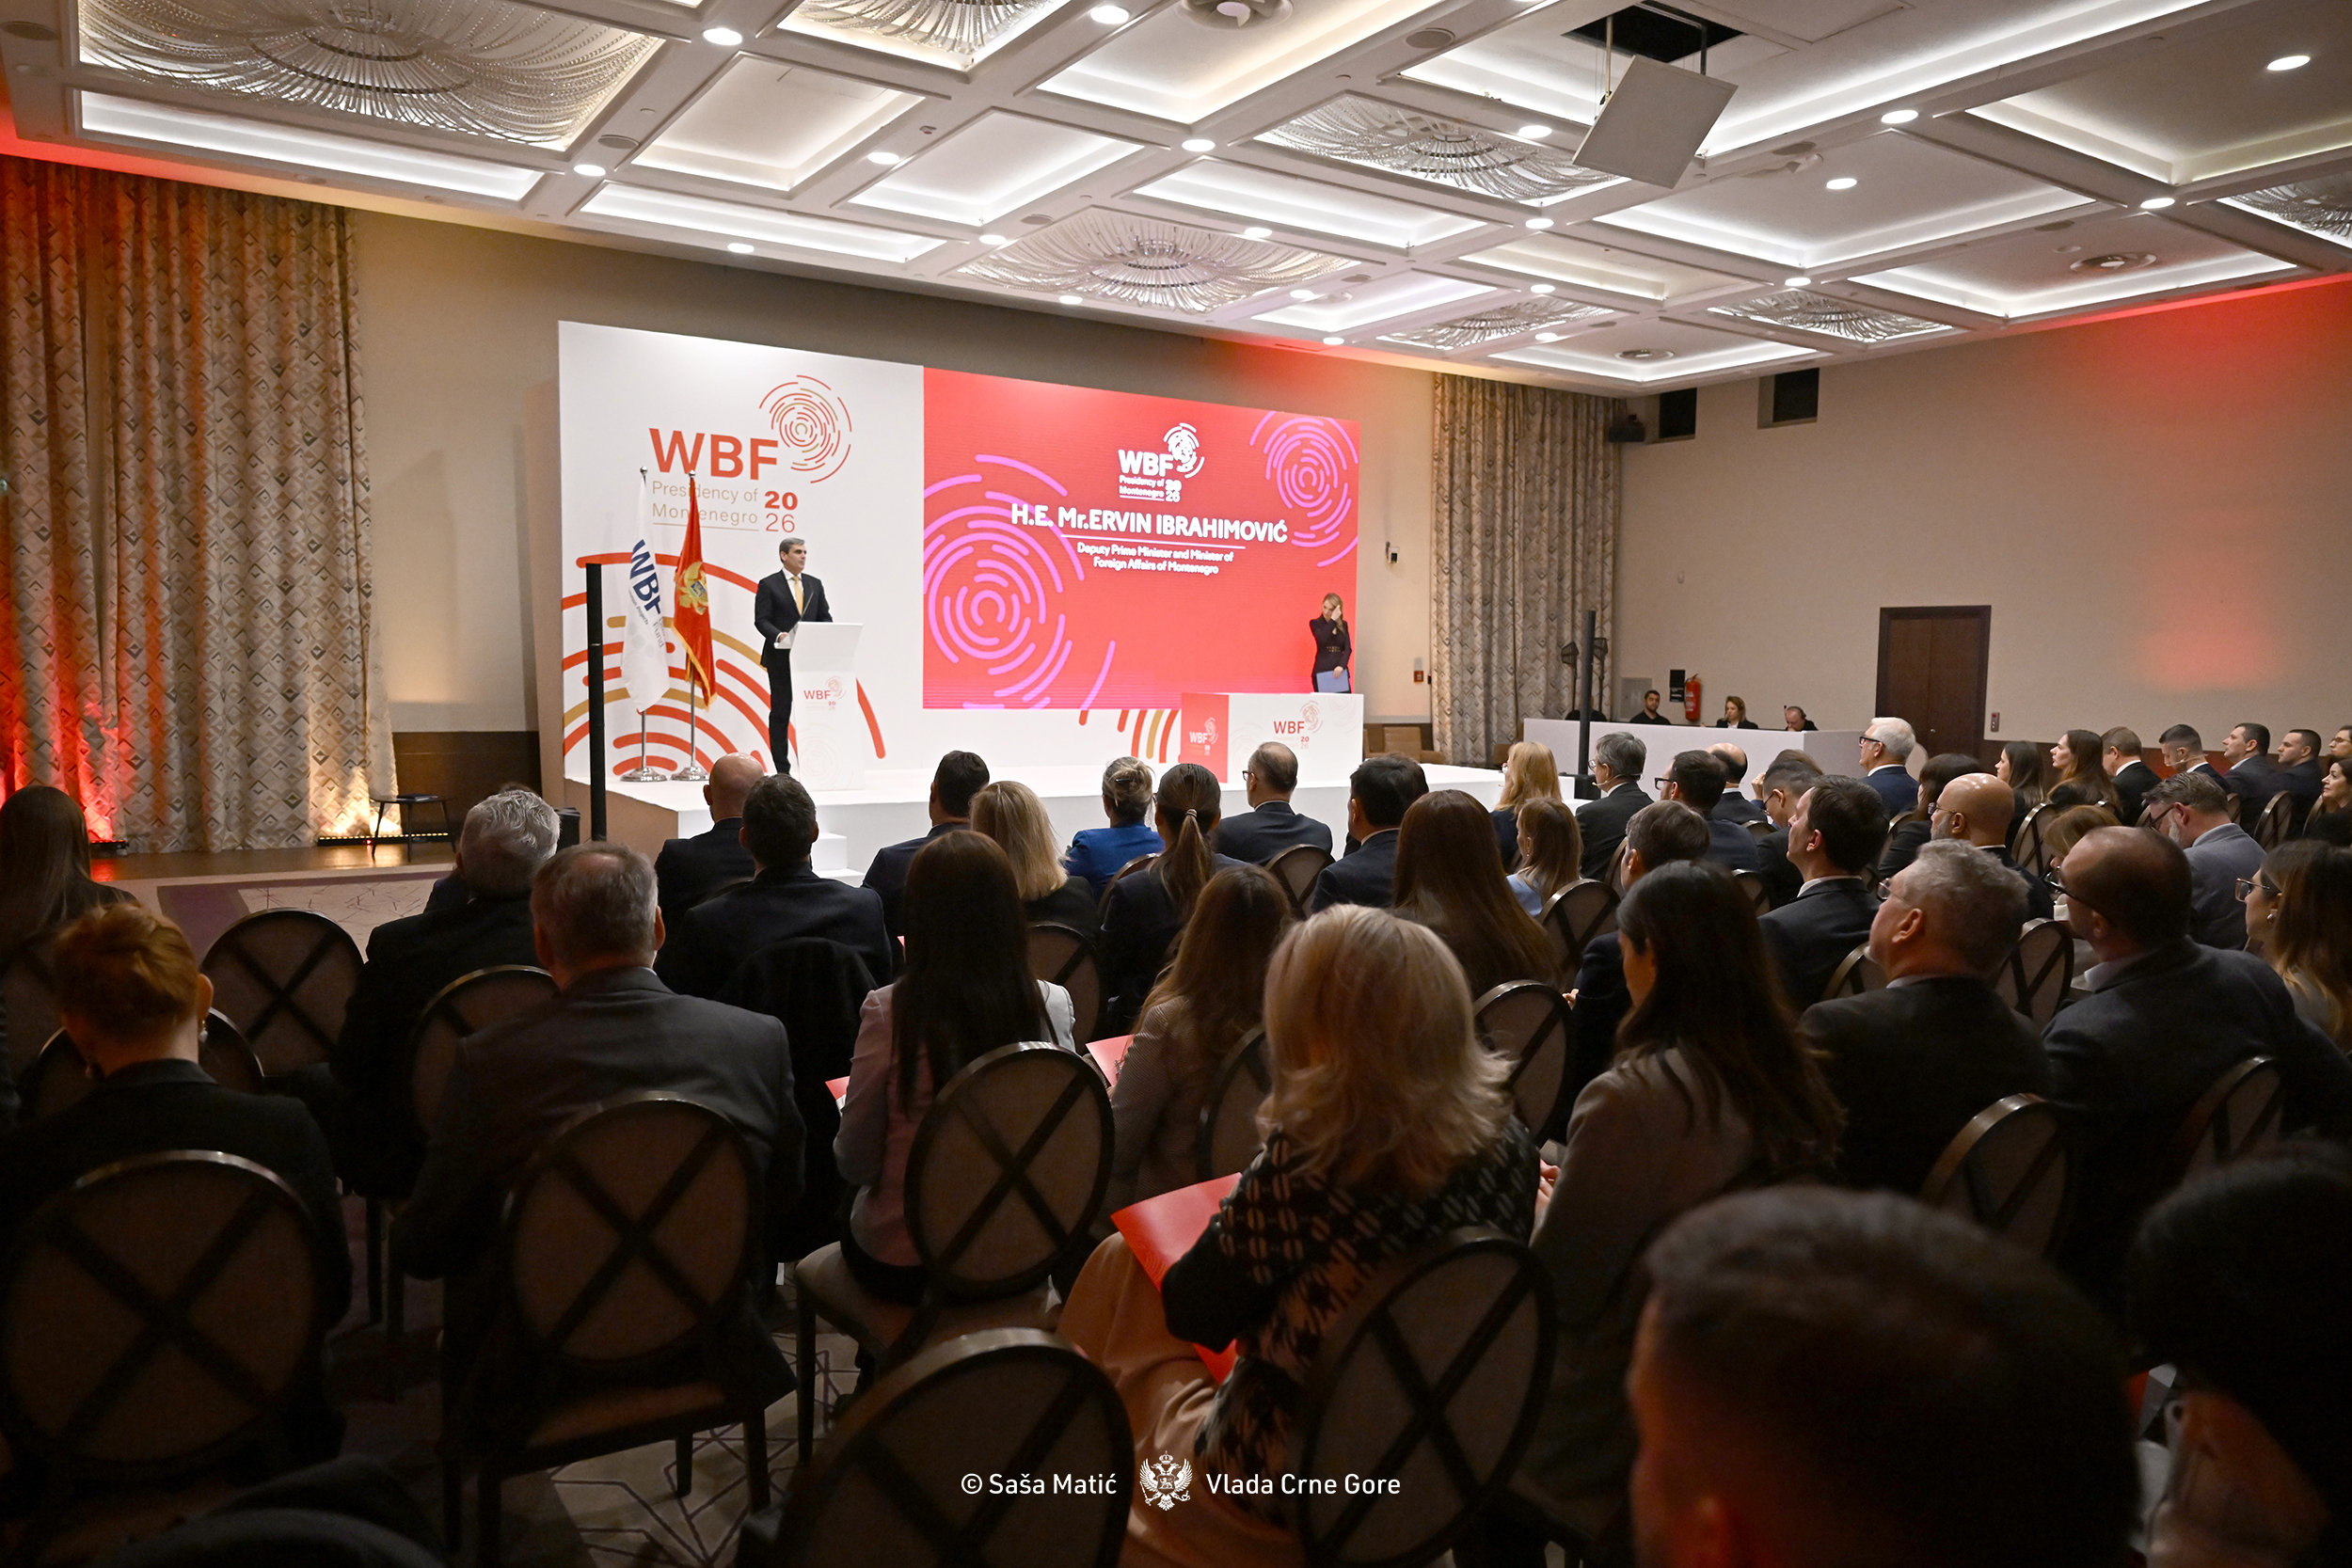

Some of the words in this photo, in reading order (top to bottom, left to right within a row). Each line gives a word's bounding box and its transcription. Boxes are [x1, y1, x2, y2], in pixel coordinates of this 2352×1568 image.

[648, 427, 778, 481] WBF
[1118, 449, 1174, 477] WBF
[652, 481, 739, 504] Presdency
[743, 488, 758, 502] of
[764, 490, 798, 511] 20
[1119, 485, 1165, 499] Montenegro
[1165, 490, 1181, 503] 26
[652, 503, 758, 526] Monenegro
[765, 513, 795, 533] 26
[1011, 502, 1054, 528] H.E.
[1155, 514, 1288, 544] IBRAHIMOVIĆ
[1076, 542, 1111, 557] Deputy
[1111, 544, 1137, 556] Prime
[1137, 546, 1173, 559] Minister
[1172, 548, 1190, 560] and
[1190, 549, 1224, 562] Minister
[1223, 551, 1234, 562] of
[629, 539, 661, 615] WBF
[1093, 556, 1127, 571] Foreign
[1127, 559, 1156, 571] Affairs
[1156, 561, 1168, 572] of
[1168, 562, 1219, 577] Montenegro
[803, 689, 831, 700] WBF
[1189, 731, 1208, 744] WBF
[1273, 721, 1305, 734] WBF
